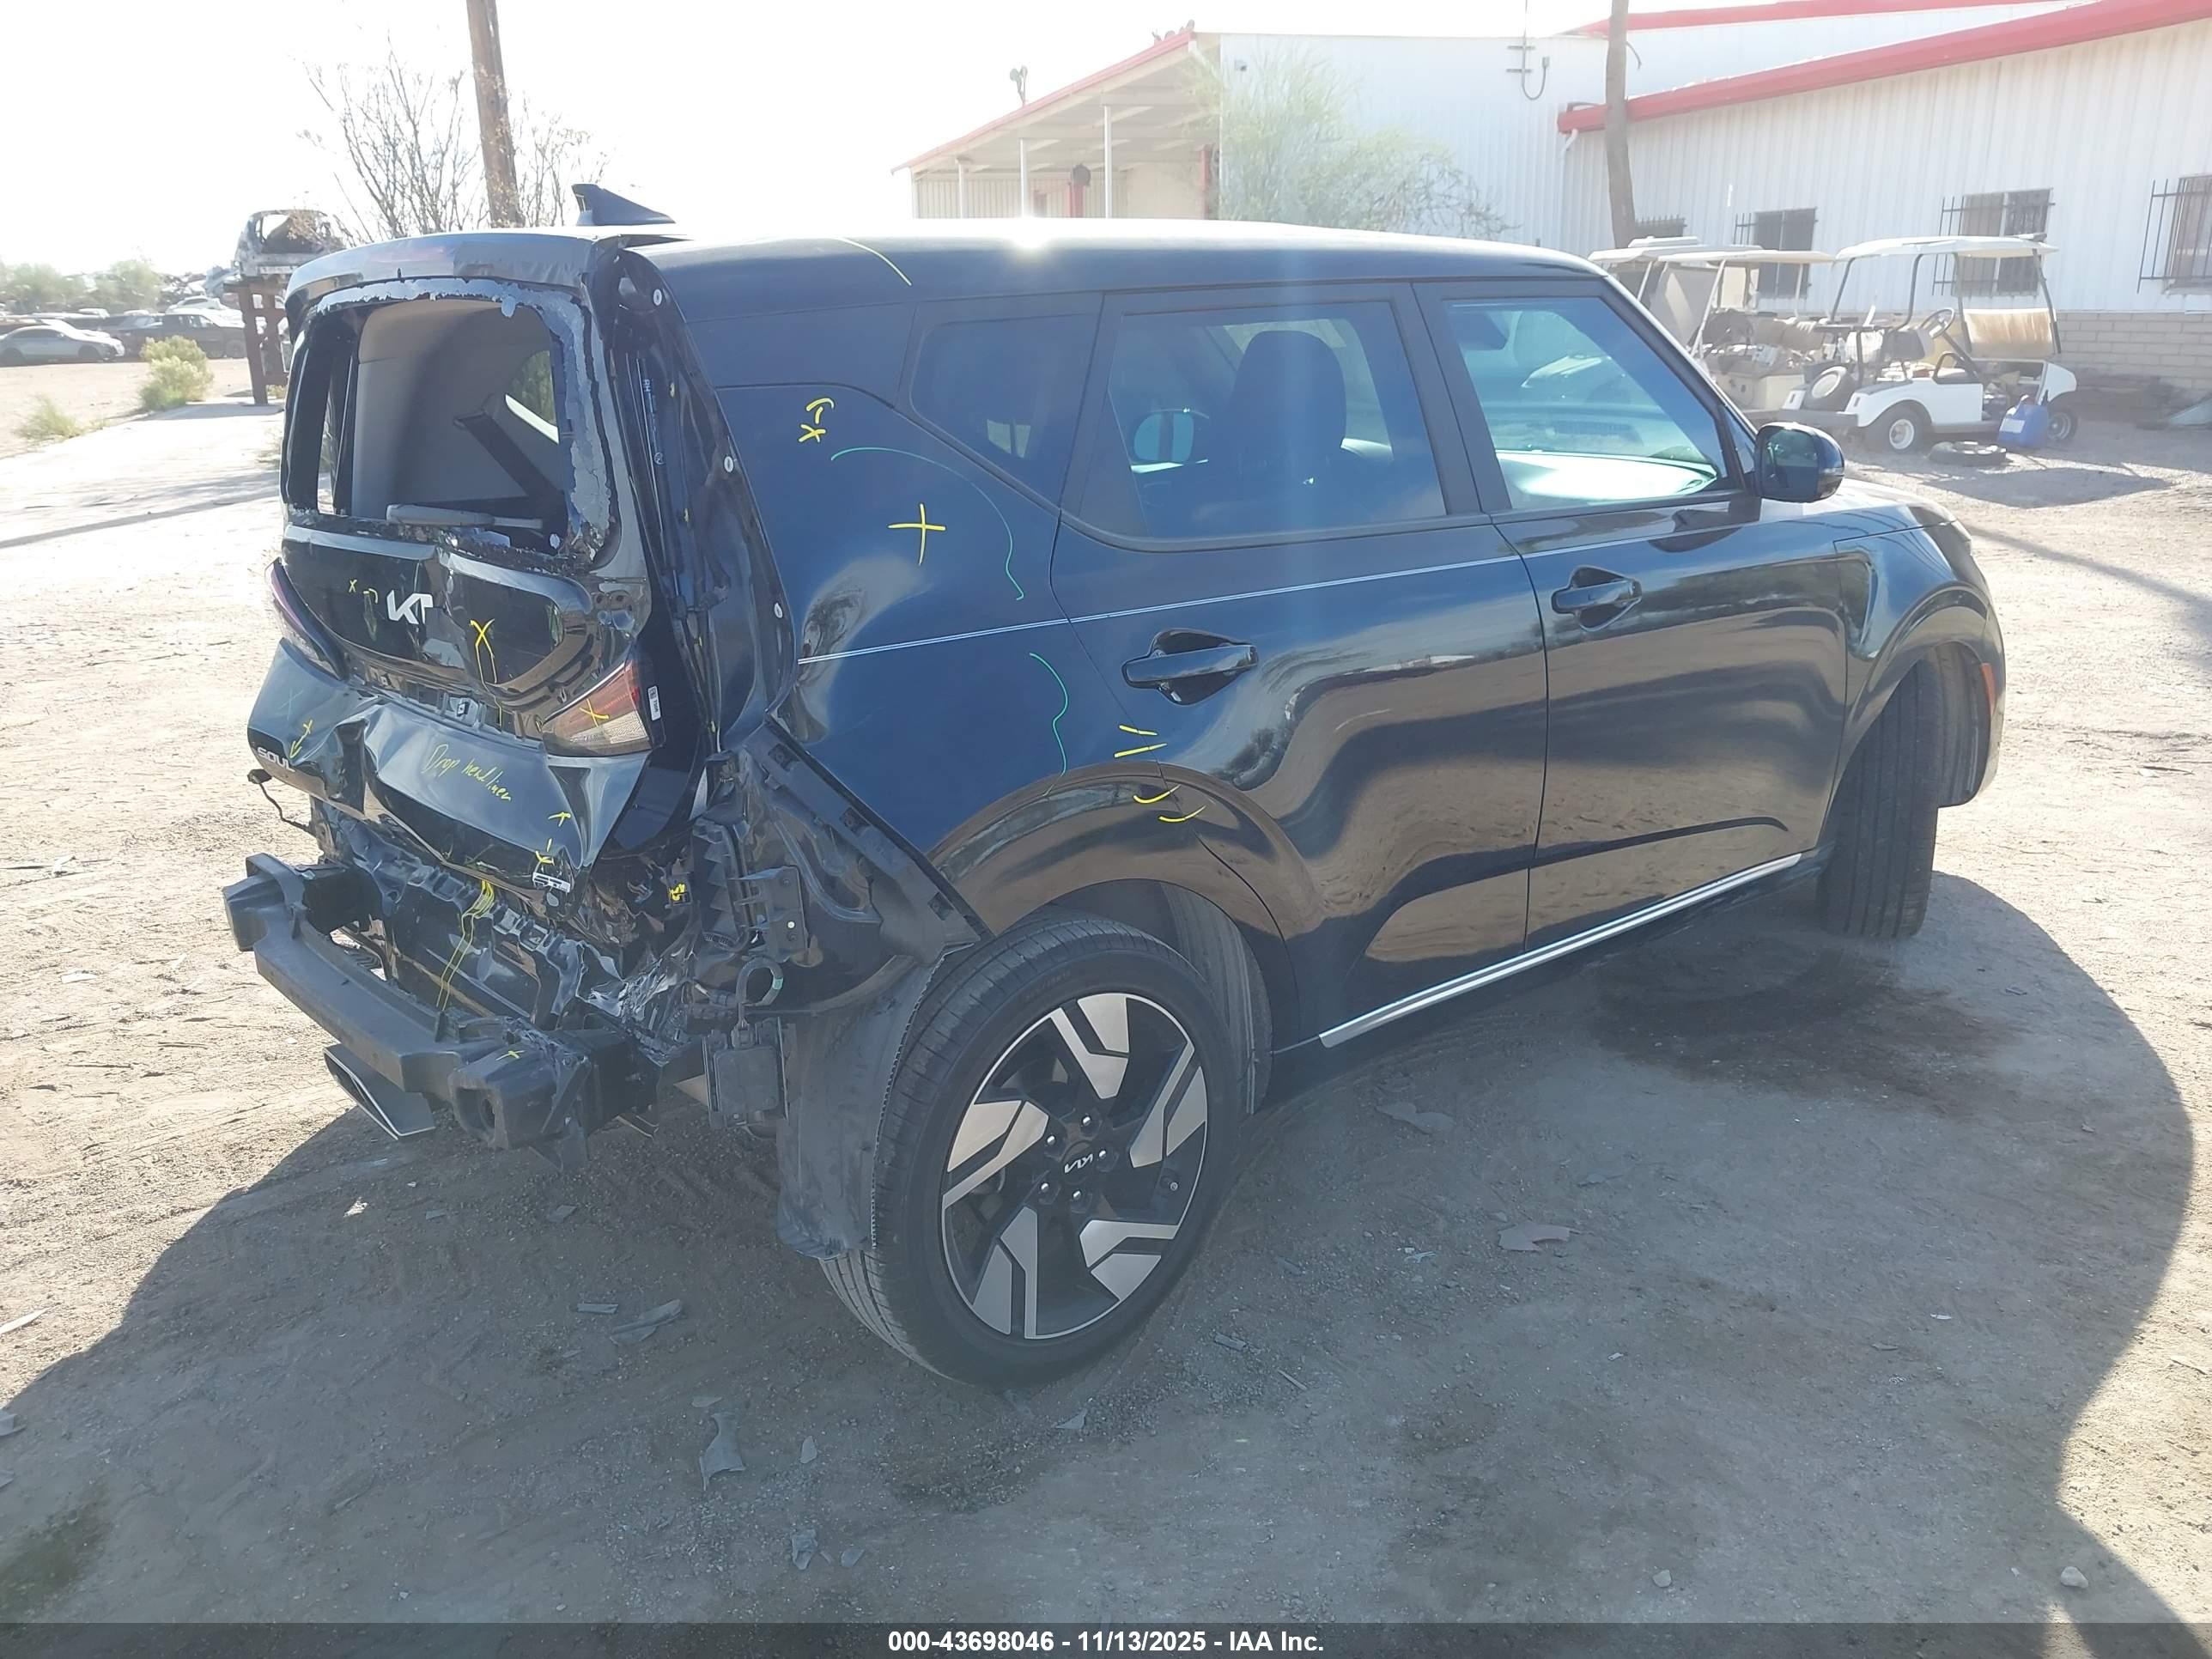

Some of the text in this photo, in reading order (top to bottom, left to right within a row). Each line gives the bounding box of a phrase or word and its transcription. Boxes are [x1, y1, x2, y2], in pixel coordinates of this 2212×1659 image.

[258, 746, 296, 773] SOUL
[421, 744, 460, 777] Drop
[1064, 1153, 1094, 1174] KIA
